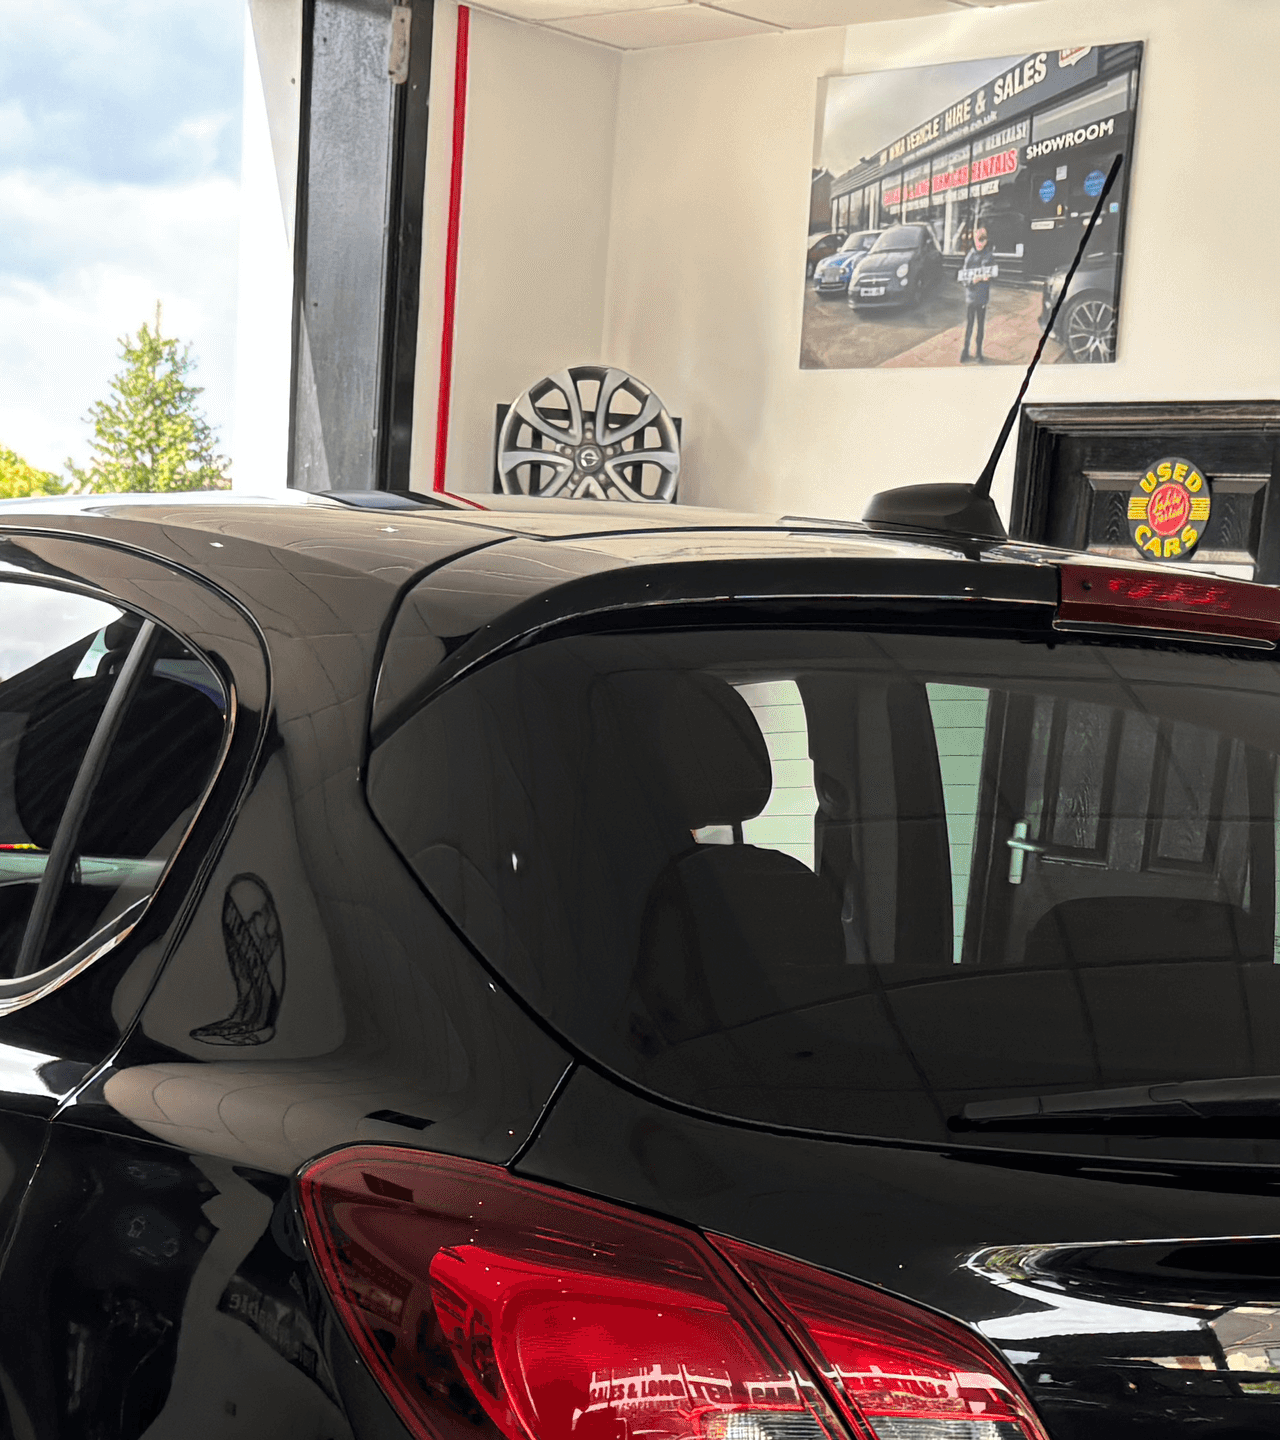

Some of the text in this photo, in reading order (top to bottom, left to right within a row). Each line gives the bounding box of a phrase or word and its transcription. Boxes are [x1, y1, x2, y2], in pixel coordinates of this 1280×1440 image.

[945, 98, 971, 131] HIRE
[975, 90, 986, 115] &
[993, 52, 1048, 105] SALES
[1026, 118, 1114, 160] SHOWROOM
[1139, 462, 1203, 493] USED
[1135, 525, 1198, 558] CARS
